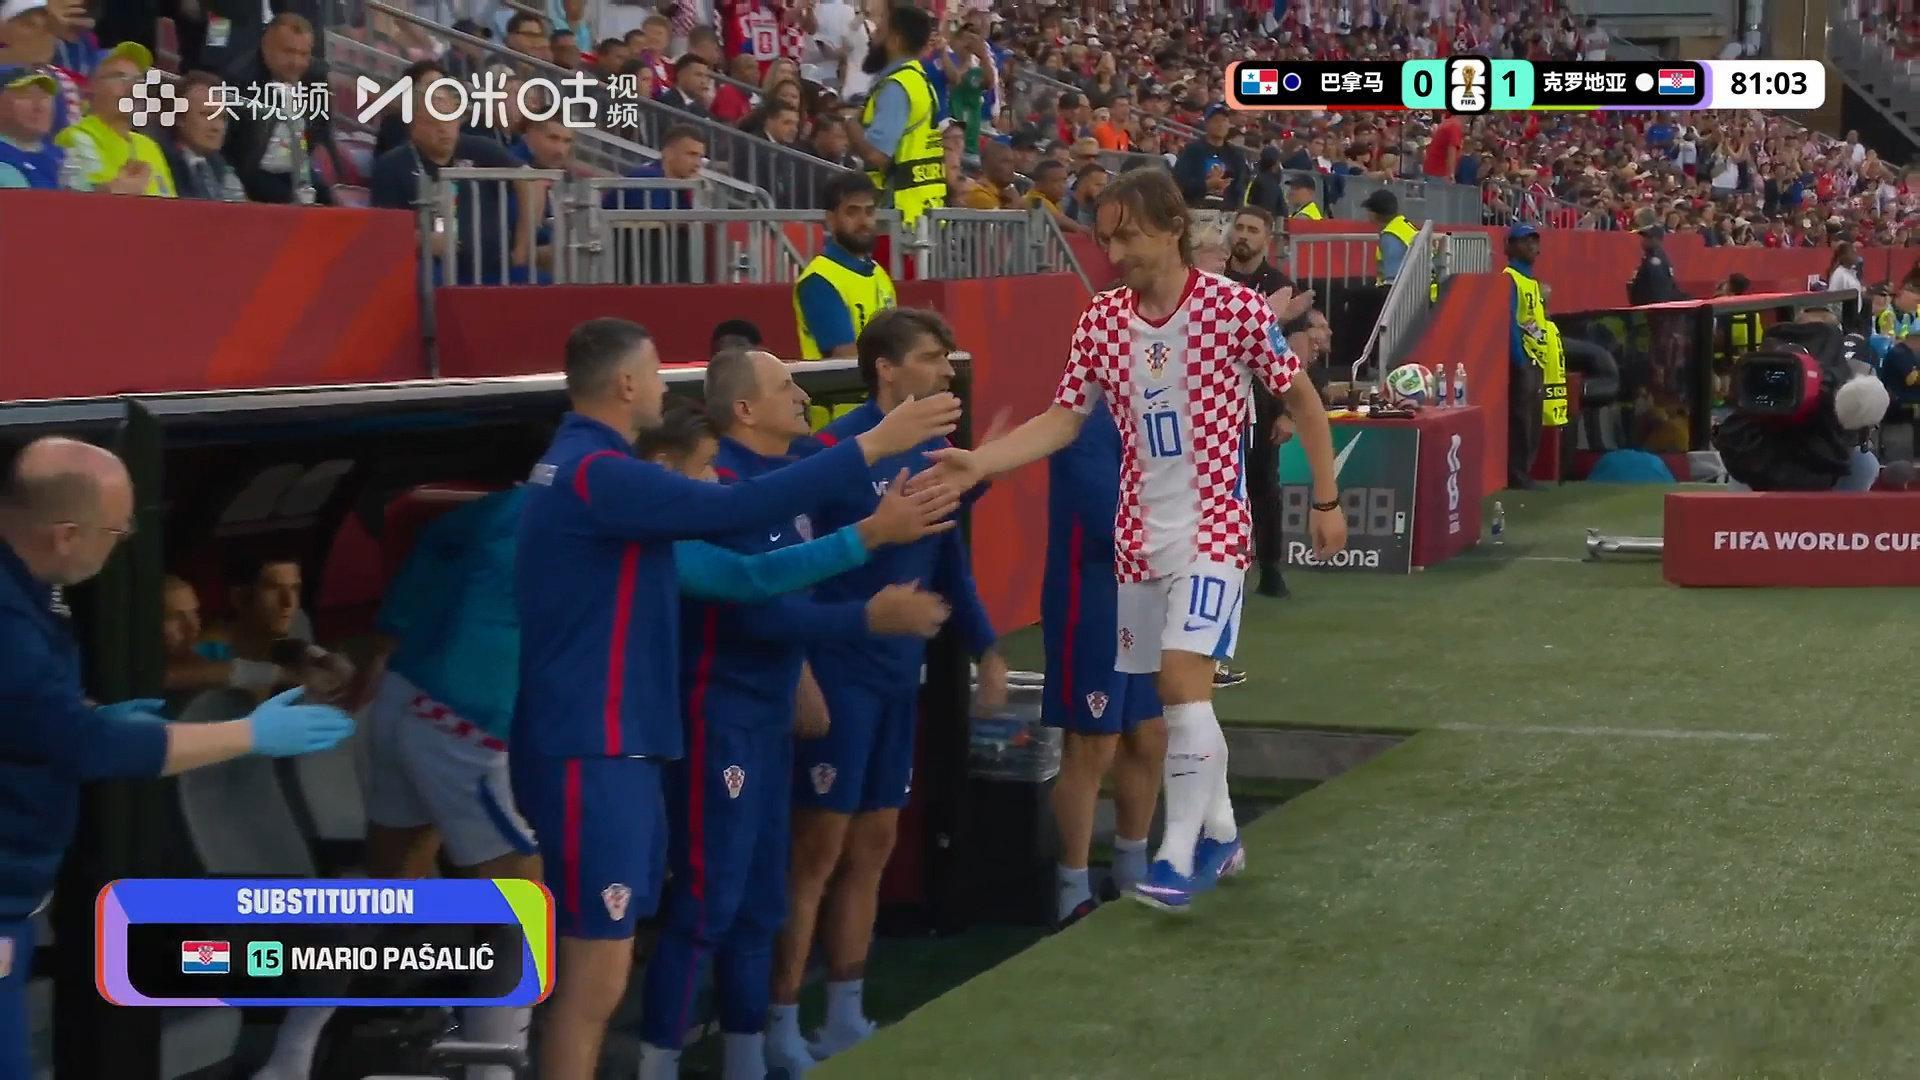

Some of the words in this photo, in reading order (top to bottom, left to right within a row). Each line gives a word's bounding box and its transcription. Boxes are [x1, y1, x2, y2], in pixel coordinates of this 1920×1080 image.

[1142, 411, 1183, 458] 10
[1714, 531, 1770, 550] FIFA
[1774, 531, 1870, 551] WORLD
[1188, 574, 1226, 623] 10
